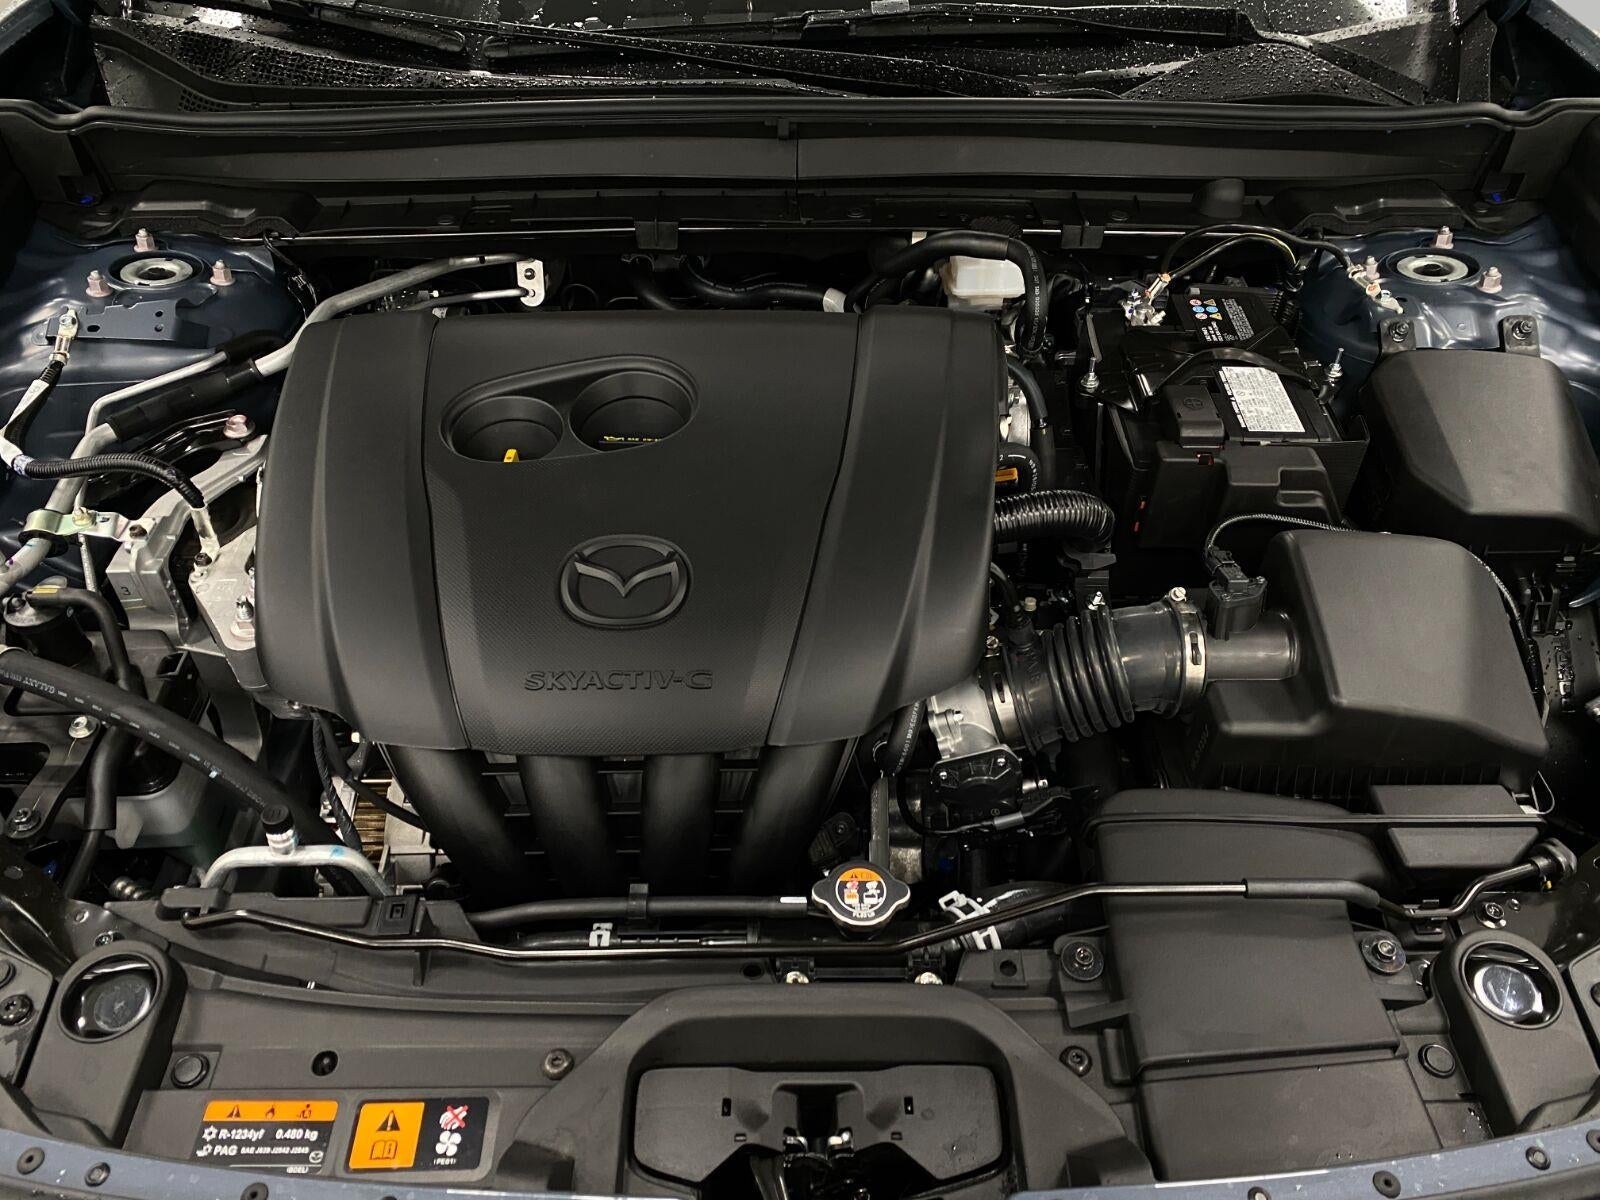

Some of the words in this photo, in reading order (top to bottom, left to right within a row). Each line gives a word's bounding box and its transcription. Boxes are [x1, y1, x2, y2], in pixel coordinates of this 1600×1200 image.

[524, 669, 714, 691] SKYACTIV-G
[218, 1128, 265, 1142] R-1234yf
[275, 1128, 303, 1141] 0.480
[304, 1128, 319, 1142] kg
[213, 1144, 239, 1156] PAG
